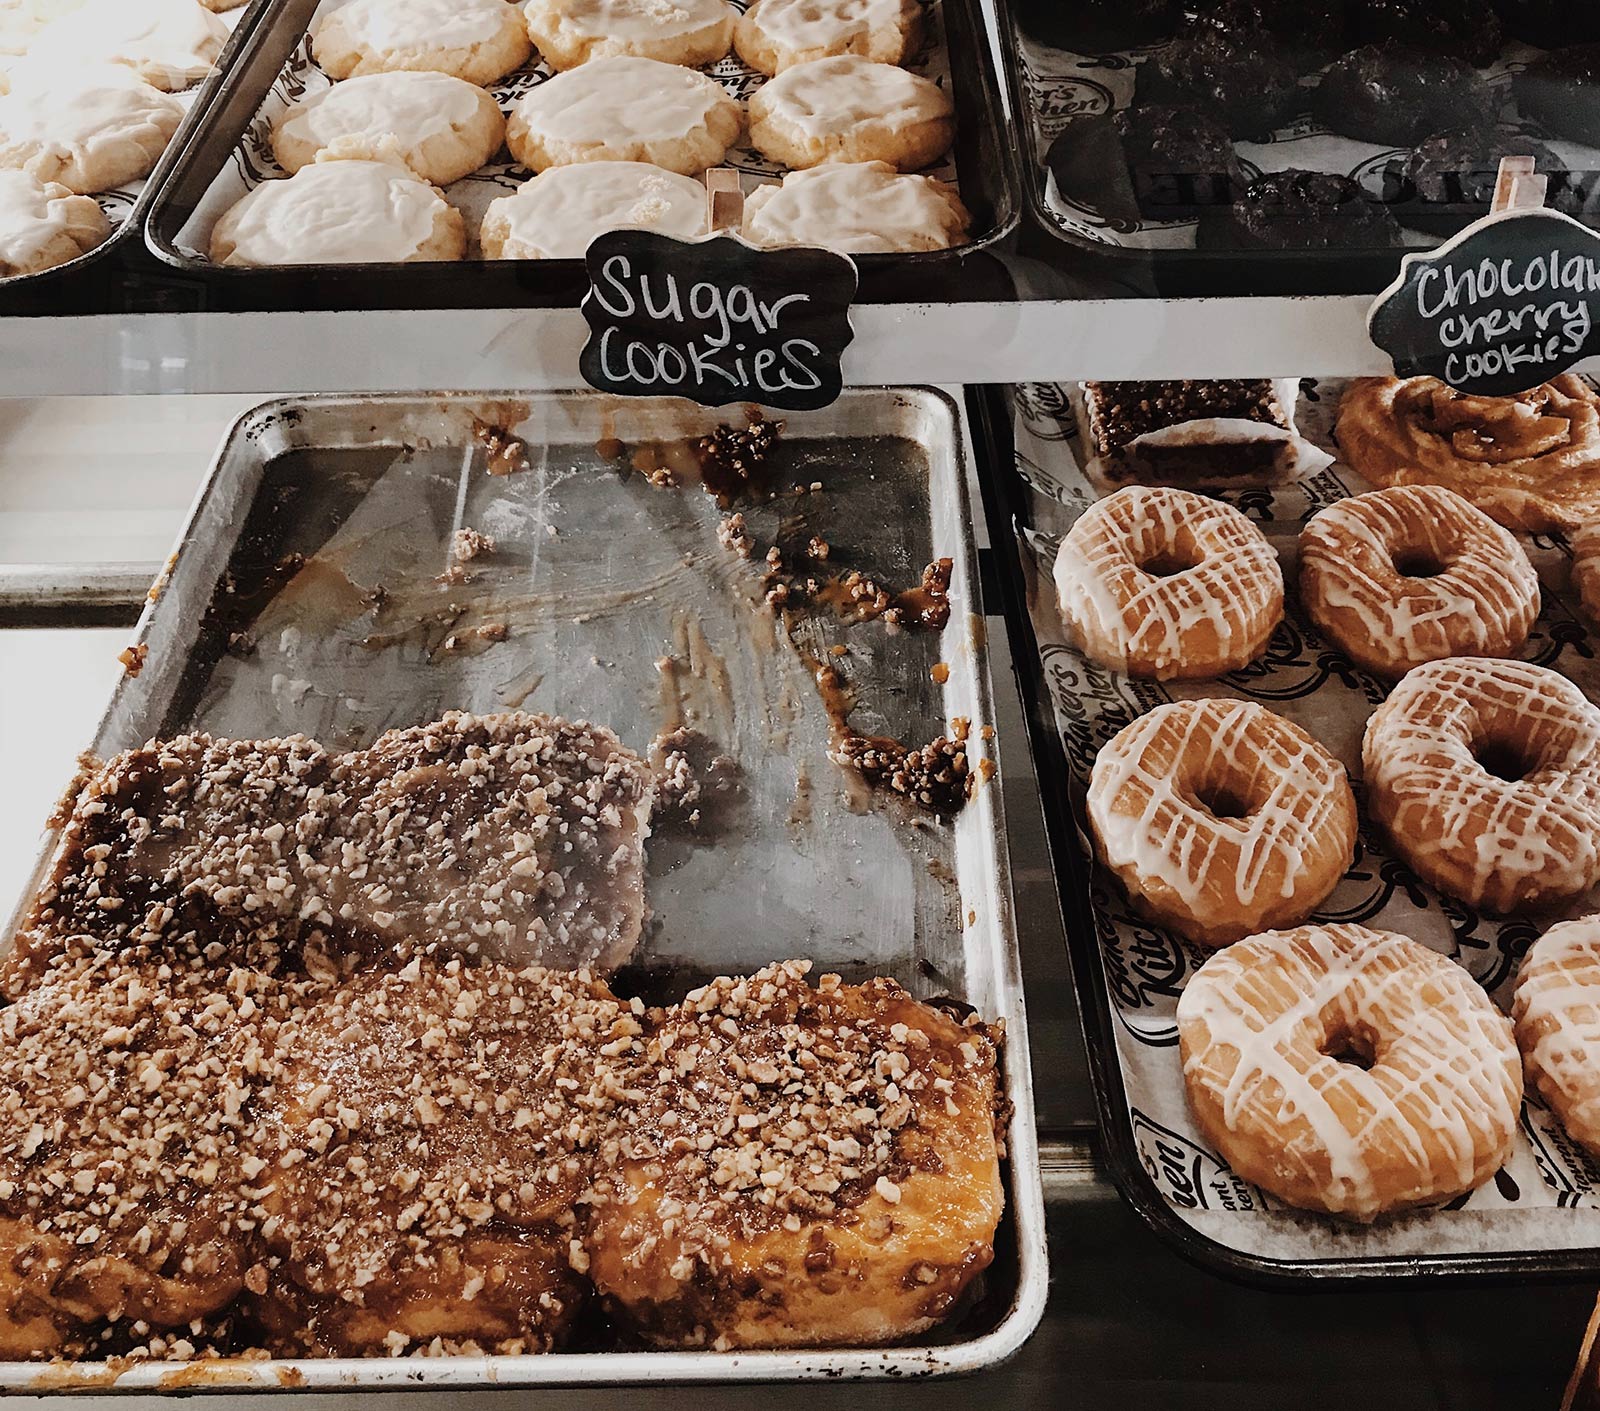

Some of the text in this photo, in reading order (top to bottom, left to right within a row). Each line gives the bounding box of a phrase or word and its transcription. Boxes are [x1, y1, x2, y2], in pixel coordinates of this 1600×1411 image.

[593, 255, 811, 347] Sugar
[1439, 299, 1591, 348] cherry
[600, 326, 822, 392] Cookies
[1445, 320, 1590, 385] cookies
[1079, 660, 1132, 740] itchen
